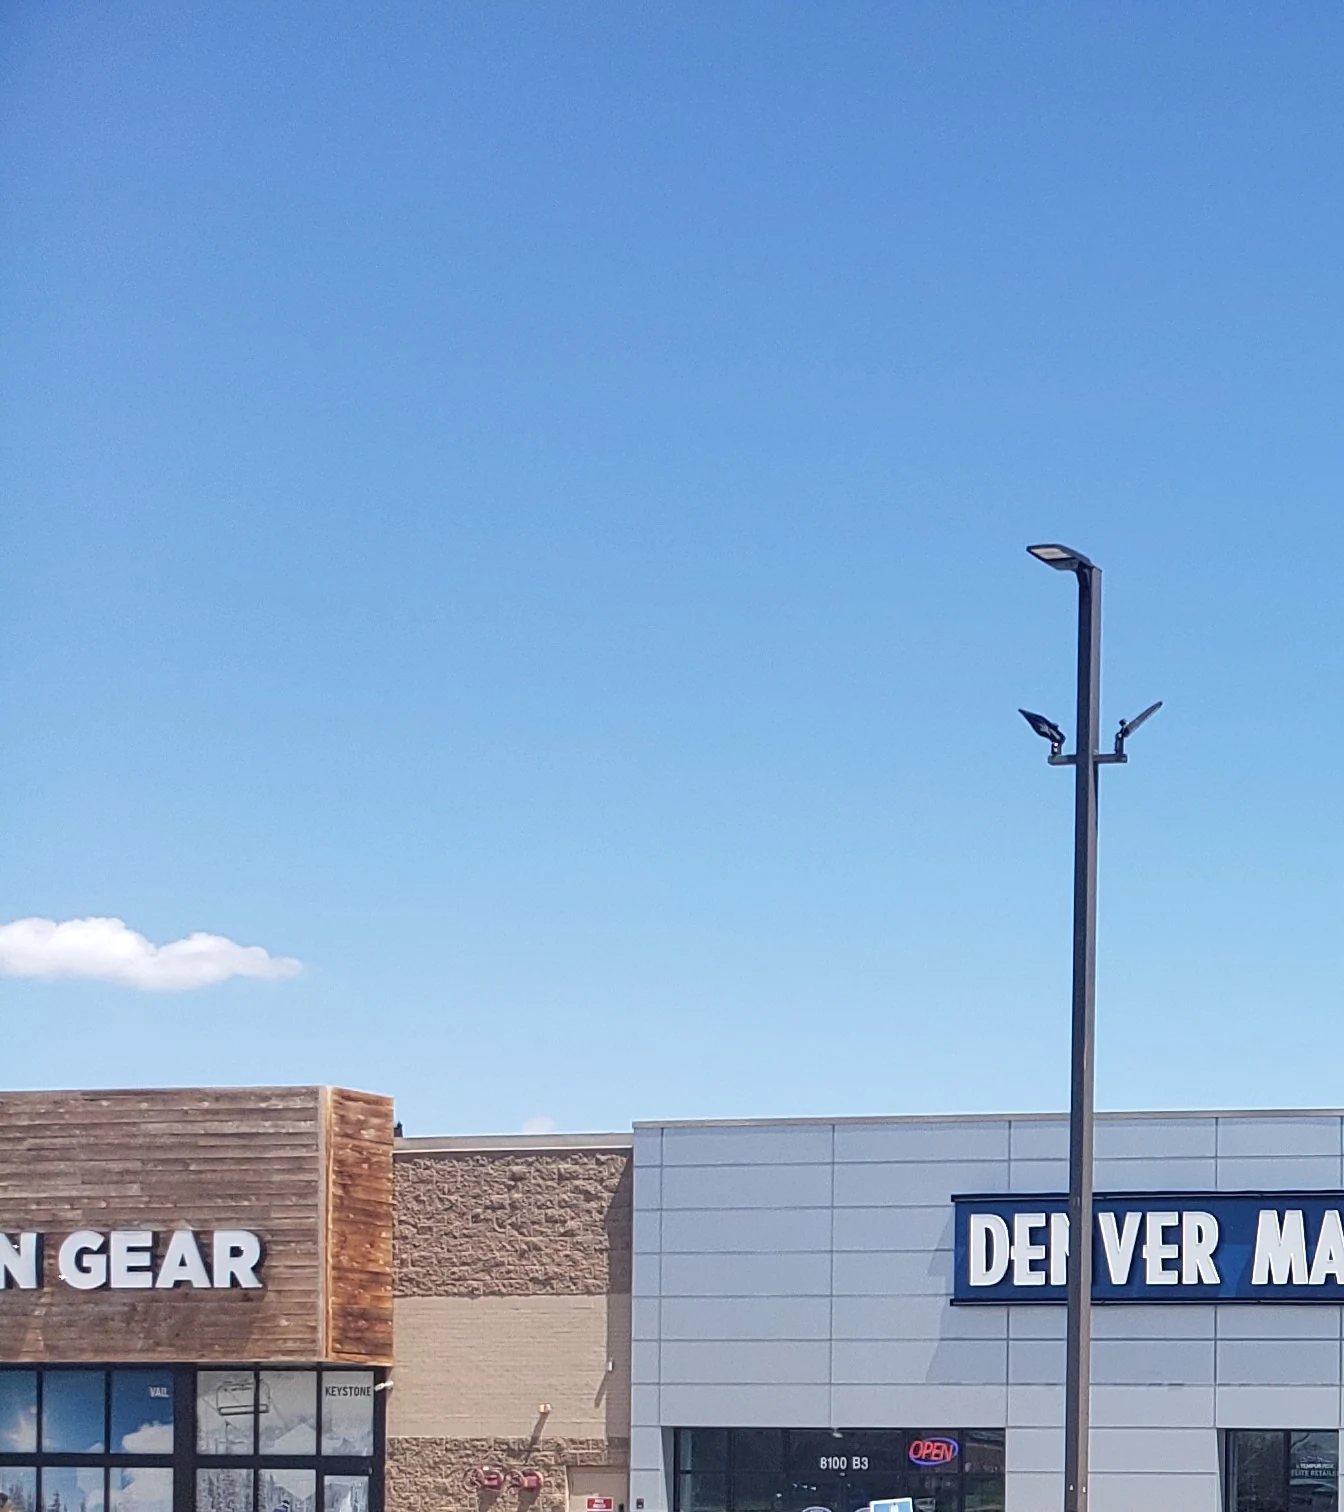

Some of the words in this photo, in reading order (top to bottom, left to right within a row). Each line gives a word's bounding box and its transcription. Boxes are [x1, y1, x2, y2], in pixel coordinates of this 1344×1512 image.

[58, 1230, 263, 1290] GEAR
[150, 1386, 169, 1397] VAIL
[325, 1386, 372, 1397] KEYSTONE
[909, 1440, 954, 1461] OPEN
[820, 1456, 848, 1470] 8100
[852, 1456, 869, 1470] B3
